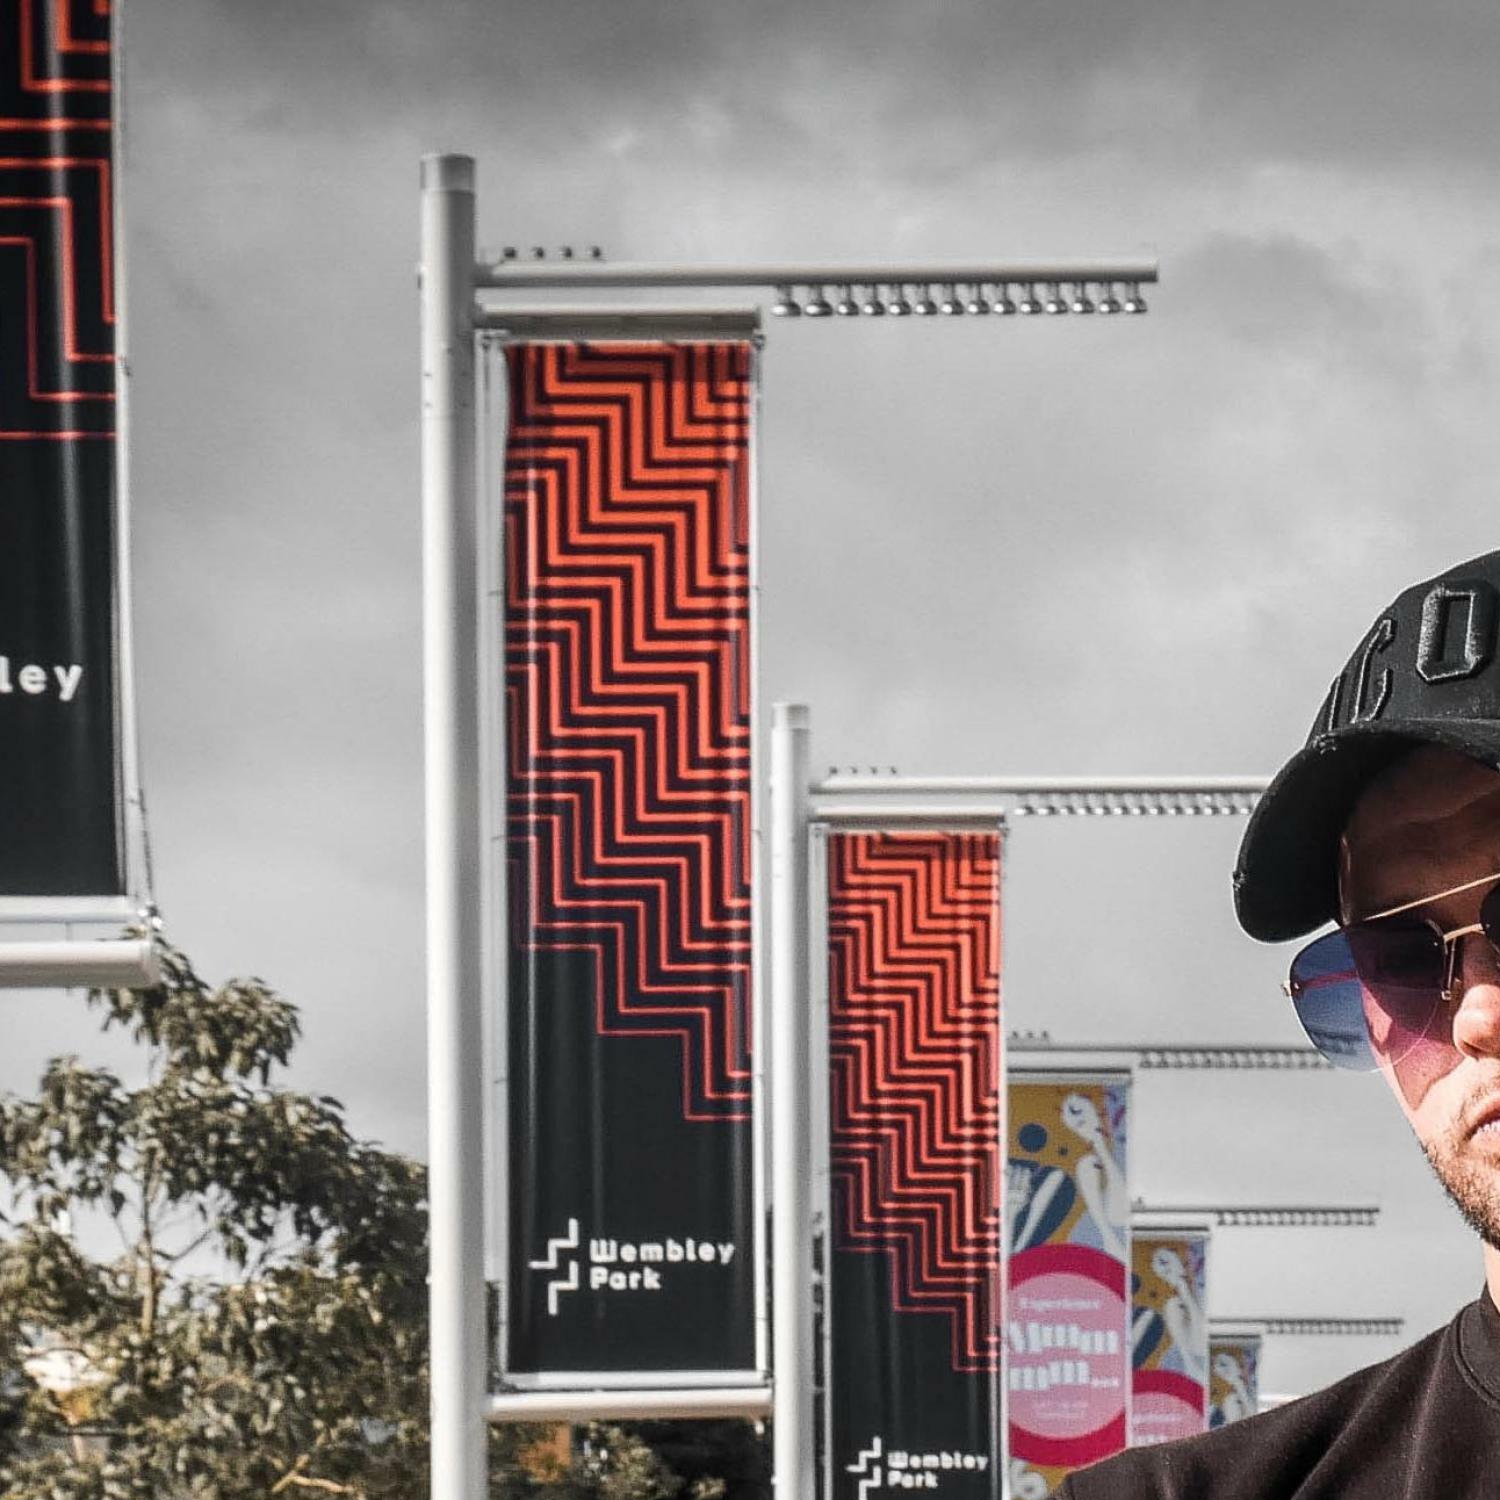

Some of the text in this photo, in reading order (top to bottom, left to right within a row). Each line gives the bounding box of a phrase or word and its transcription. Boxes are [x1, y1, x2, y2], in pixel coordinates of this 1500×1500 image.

[590, 1238, 735, 1264] Wembley
[590, 1266, 661, 1290] Park
[888, 1451, 988, 1470] Wembley
[888, 1470, 938, 1488] Park
